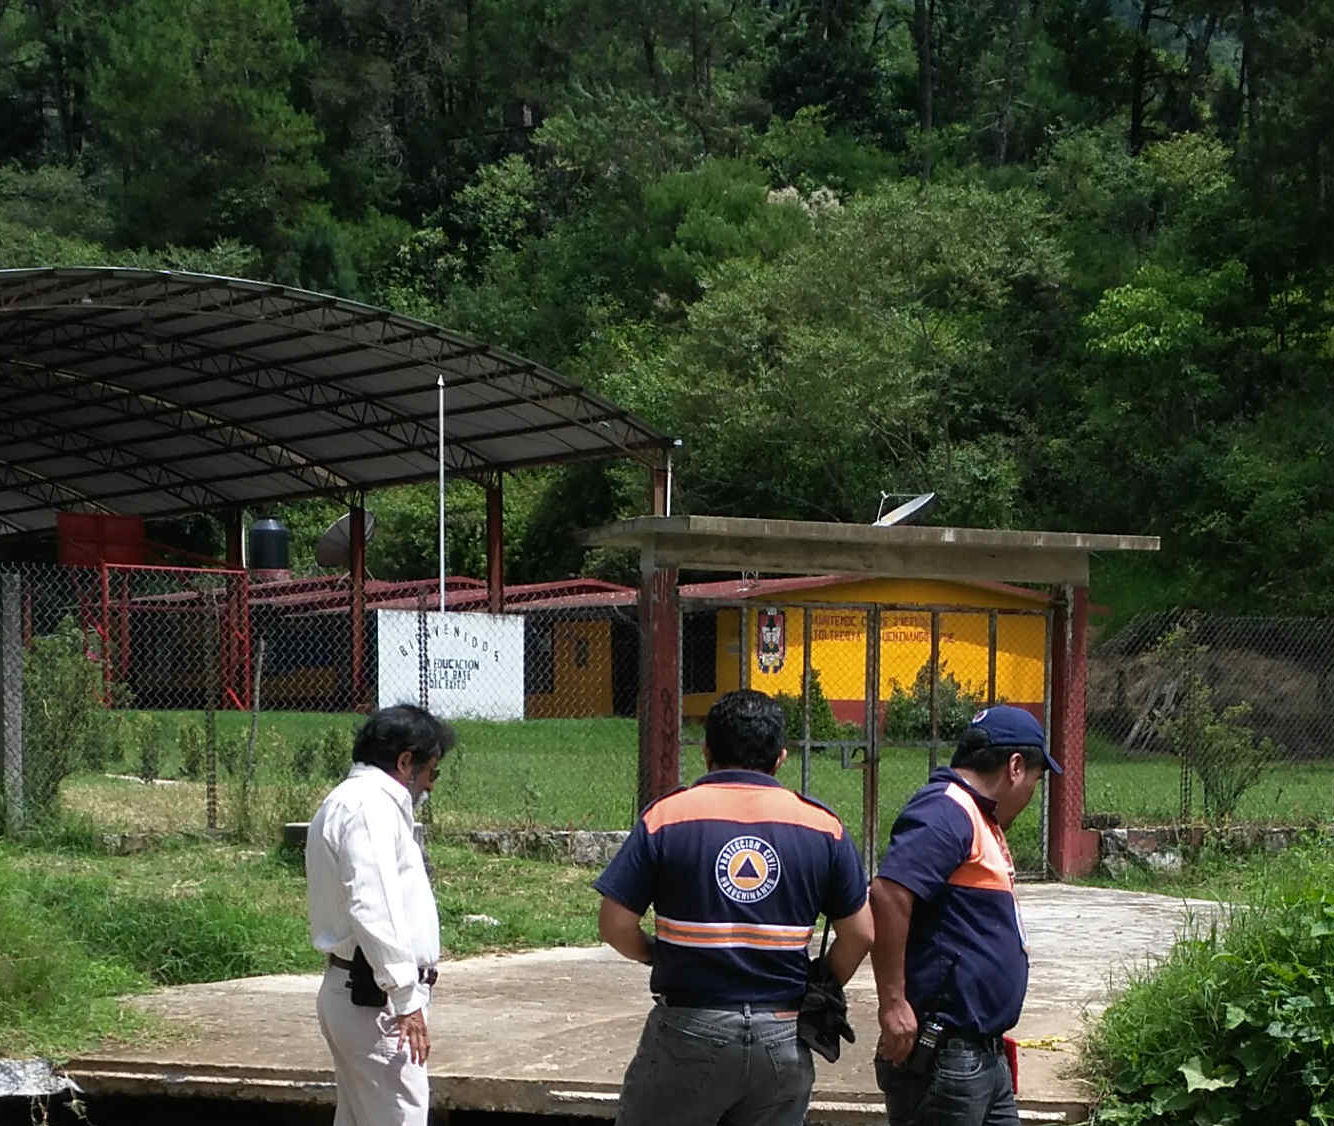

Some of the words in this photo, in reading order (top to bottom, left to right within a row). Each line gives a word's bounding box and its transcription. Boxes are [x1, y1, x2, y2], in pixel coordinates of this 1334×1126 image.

[433, 659, 479, 670] EDUCACION
[453, 670, 471, 681] BASE
[429, 681, 442, 689] DEL
[764, 849, 777, 871] CIVIL
